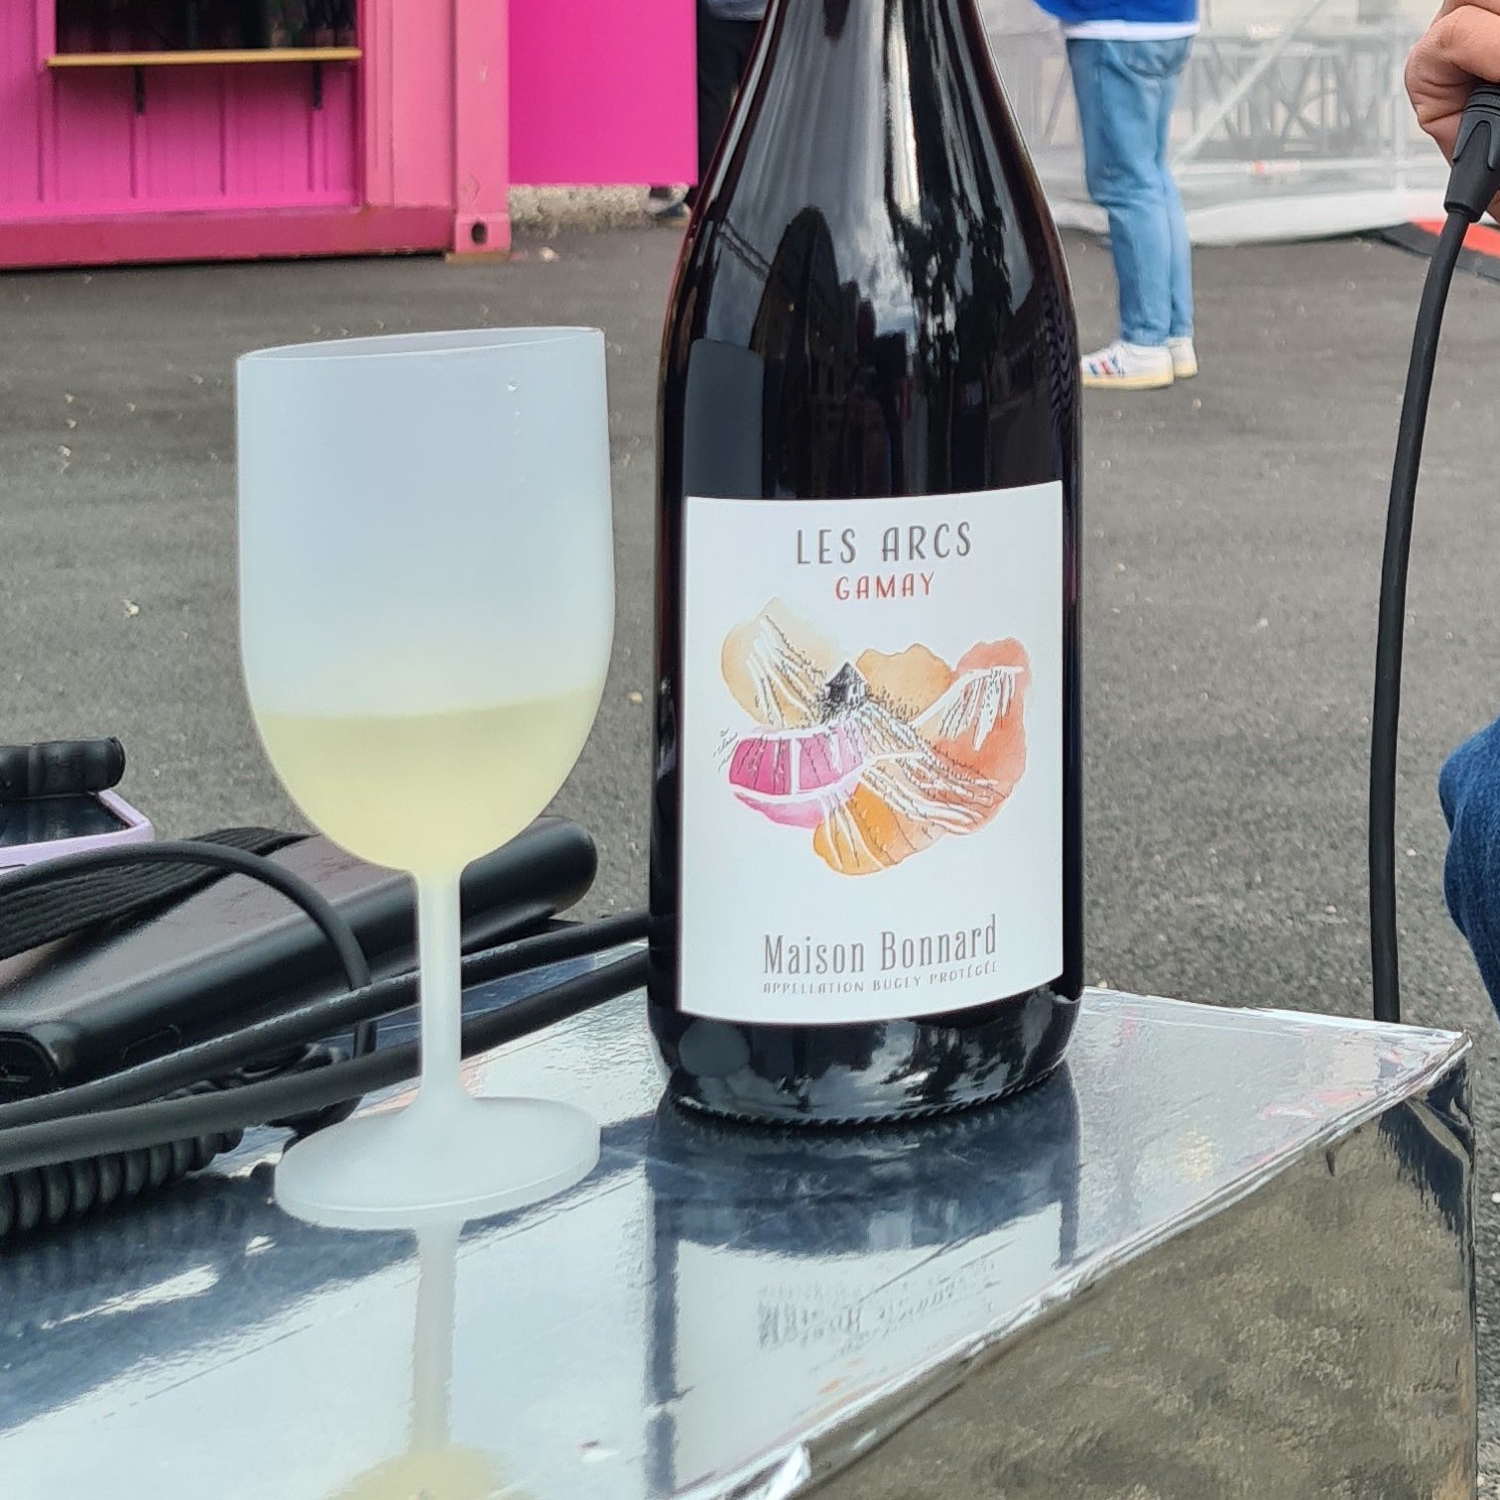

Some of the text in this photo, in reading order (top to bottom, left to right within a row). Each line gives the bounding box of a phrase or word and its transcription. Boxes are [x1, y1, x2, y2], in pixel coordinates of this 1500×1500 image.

[796, 521, 972, 565] LES ARCS
[835, 571, 935, 601] GAMAY
[763, 913, 998, 975] Maison Bonnard
[762, 980, 865, 995] APPELLATION
[872, 974, 922, 992] BUGEY
